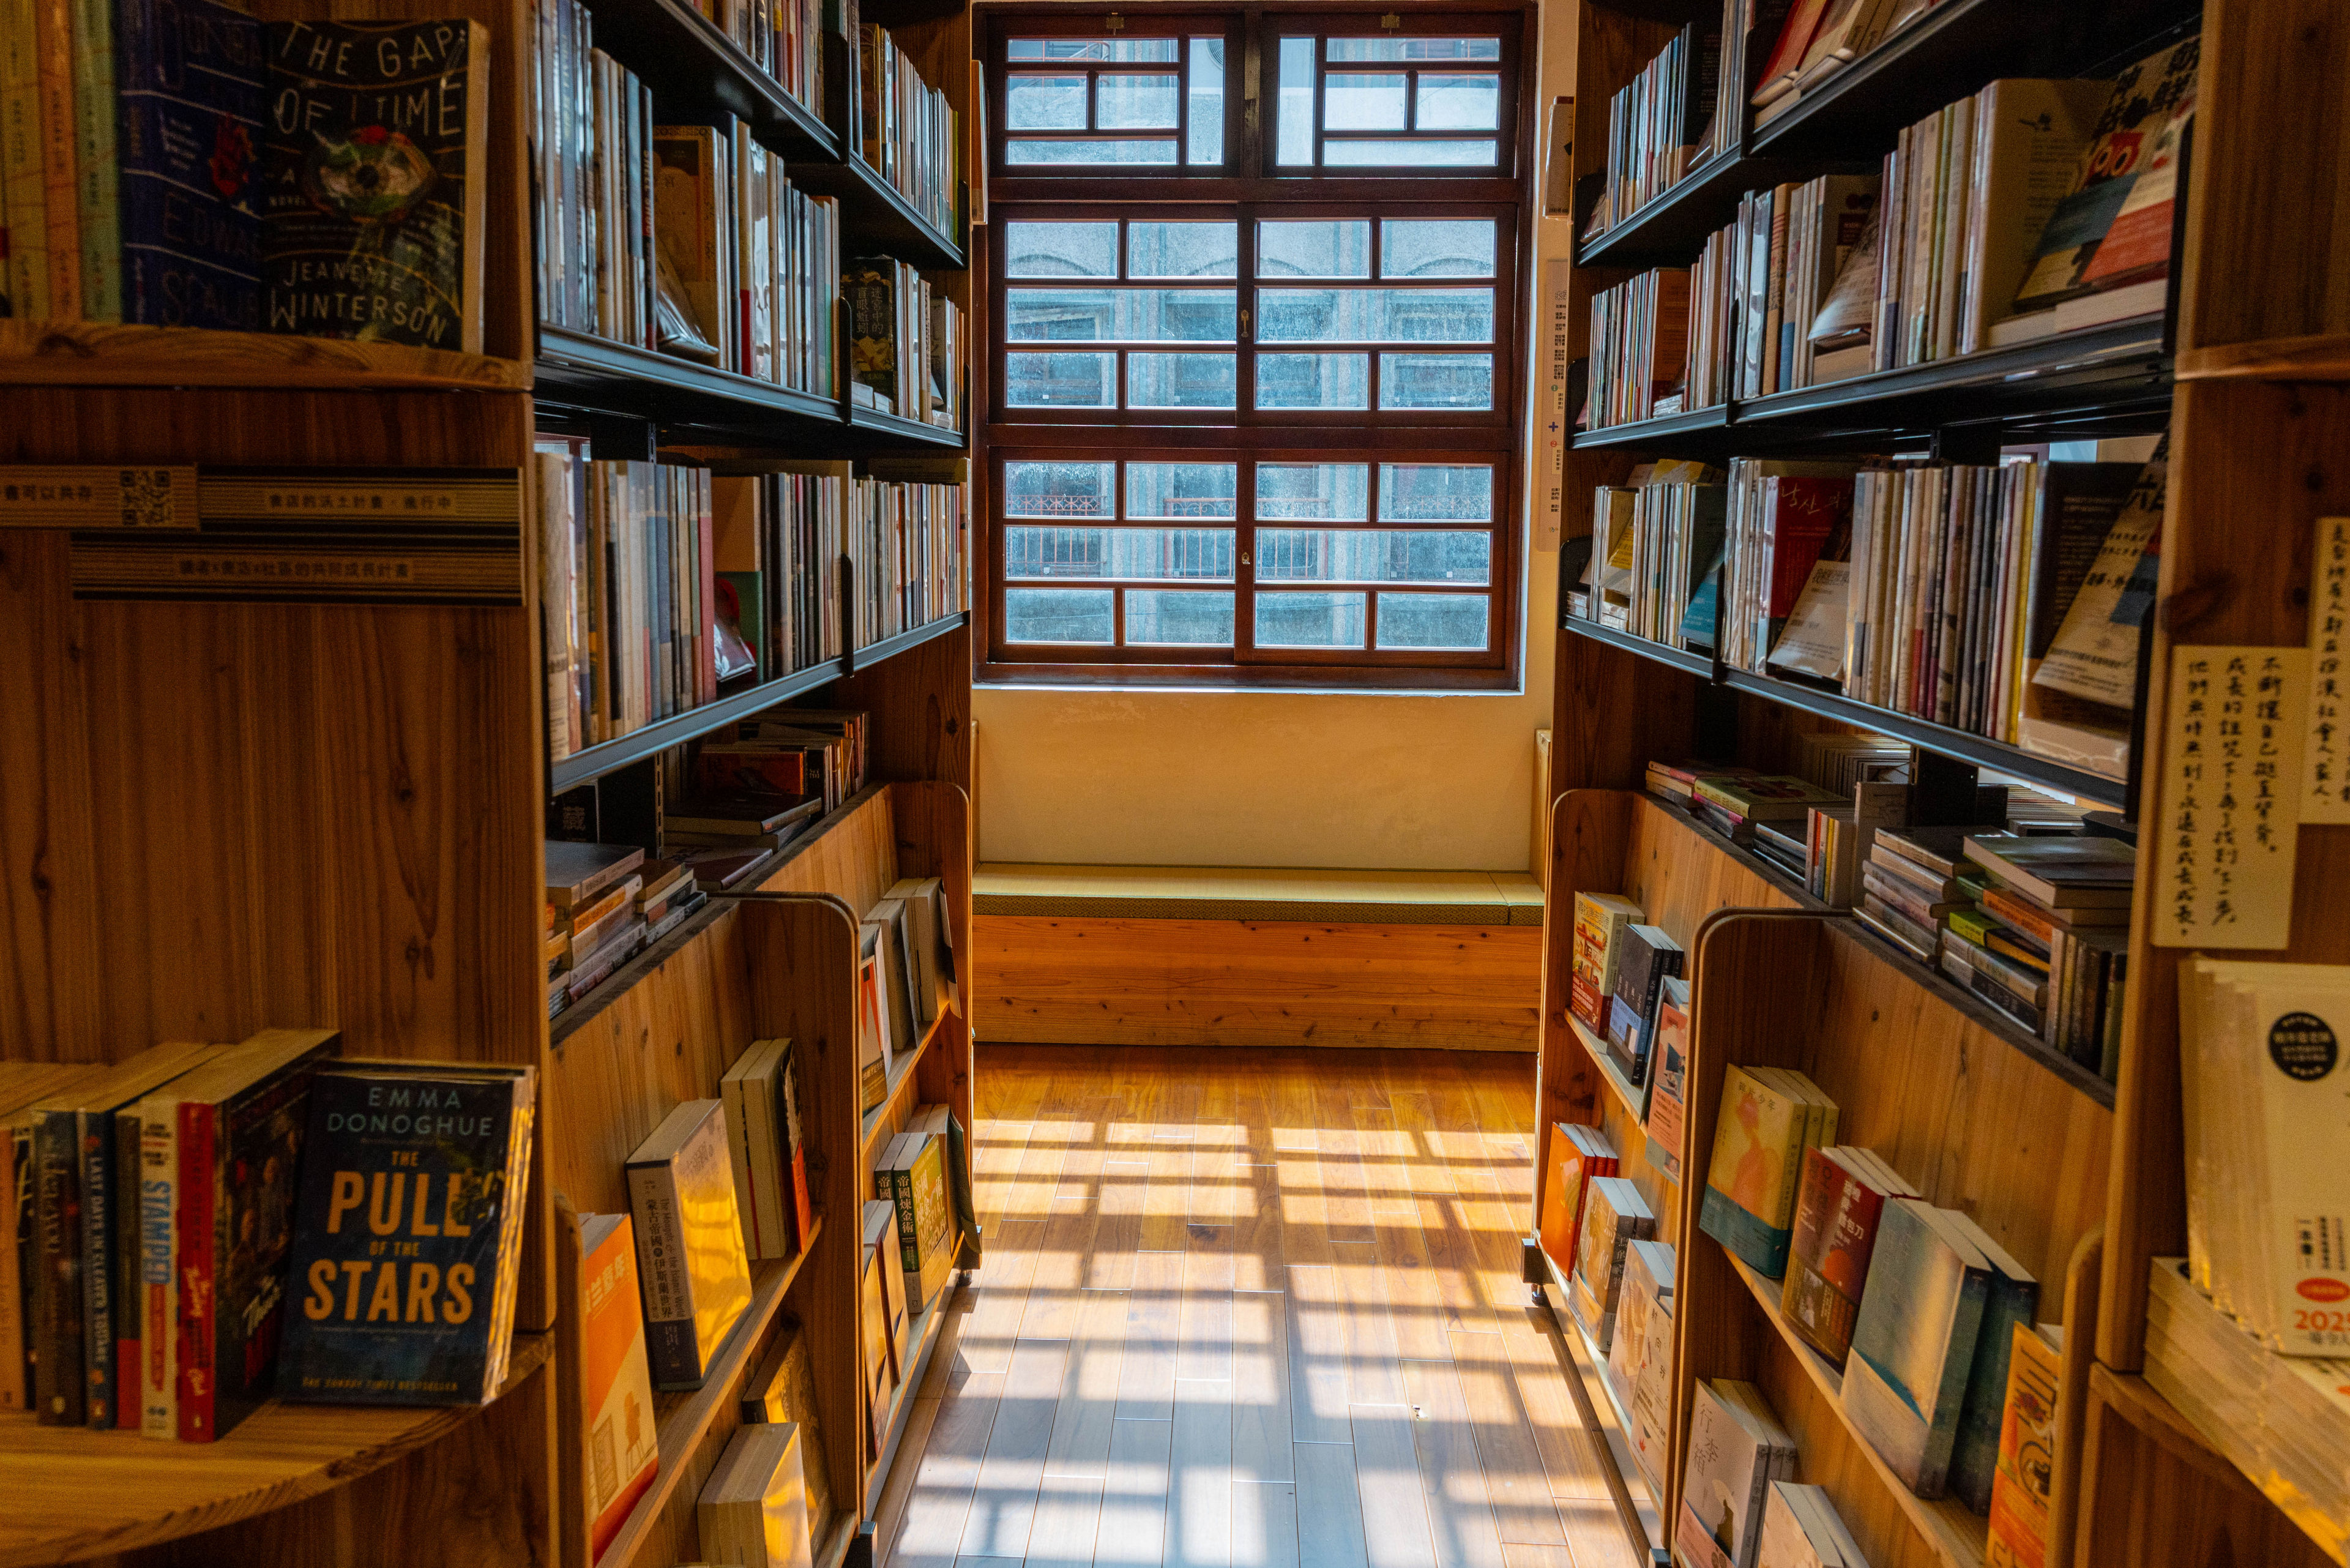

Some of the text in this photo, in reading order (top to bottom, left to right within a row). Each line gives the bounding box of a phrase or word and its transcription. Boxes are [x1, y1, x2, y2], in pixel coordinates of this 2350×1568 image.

[280, 20, 454, 78] THE GAP
[275, 81, 462, 136] OF TIME
[280, 168, 296, 184] A
[269, 286, 447, 344] WINTERSON
[326, 1112, 494, 1137] DONOGHUE
[367, 1086, 463, 1110] EMMA
[391, 1151, 420, 1168] THE
[326, 1170, 472, 1238] PULL
[897, 1175, 914, 1234] 帝國煉金術
[141, 1181, 171, 1285] STAMPED
[368, 1240, 420, 1257] OF THE
[303, 1258, 477, 1325] STARS
[2294, 1309, 2350, 1332] 202
